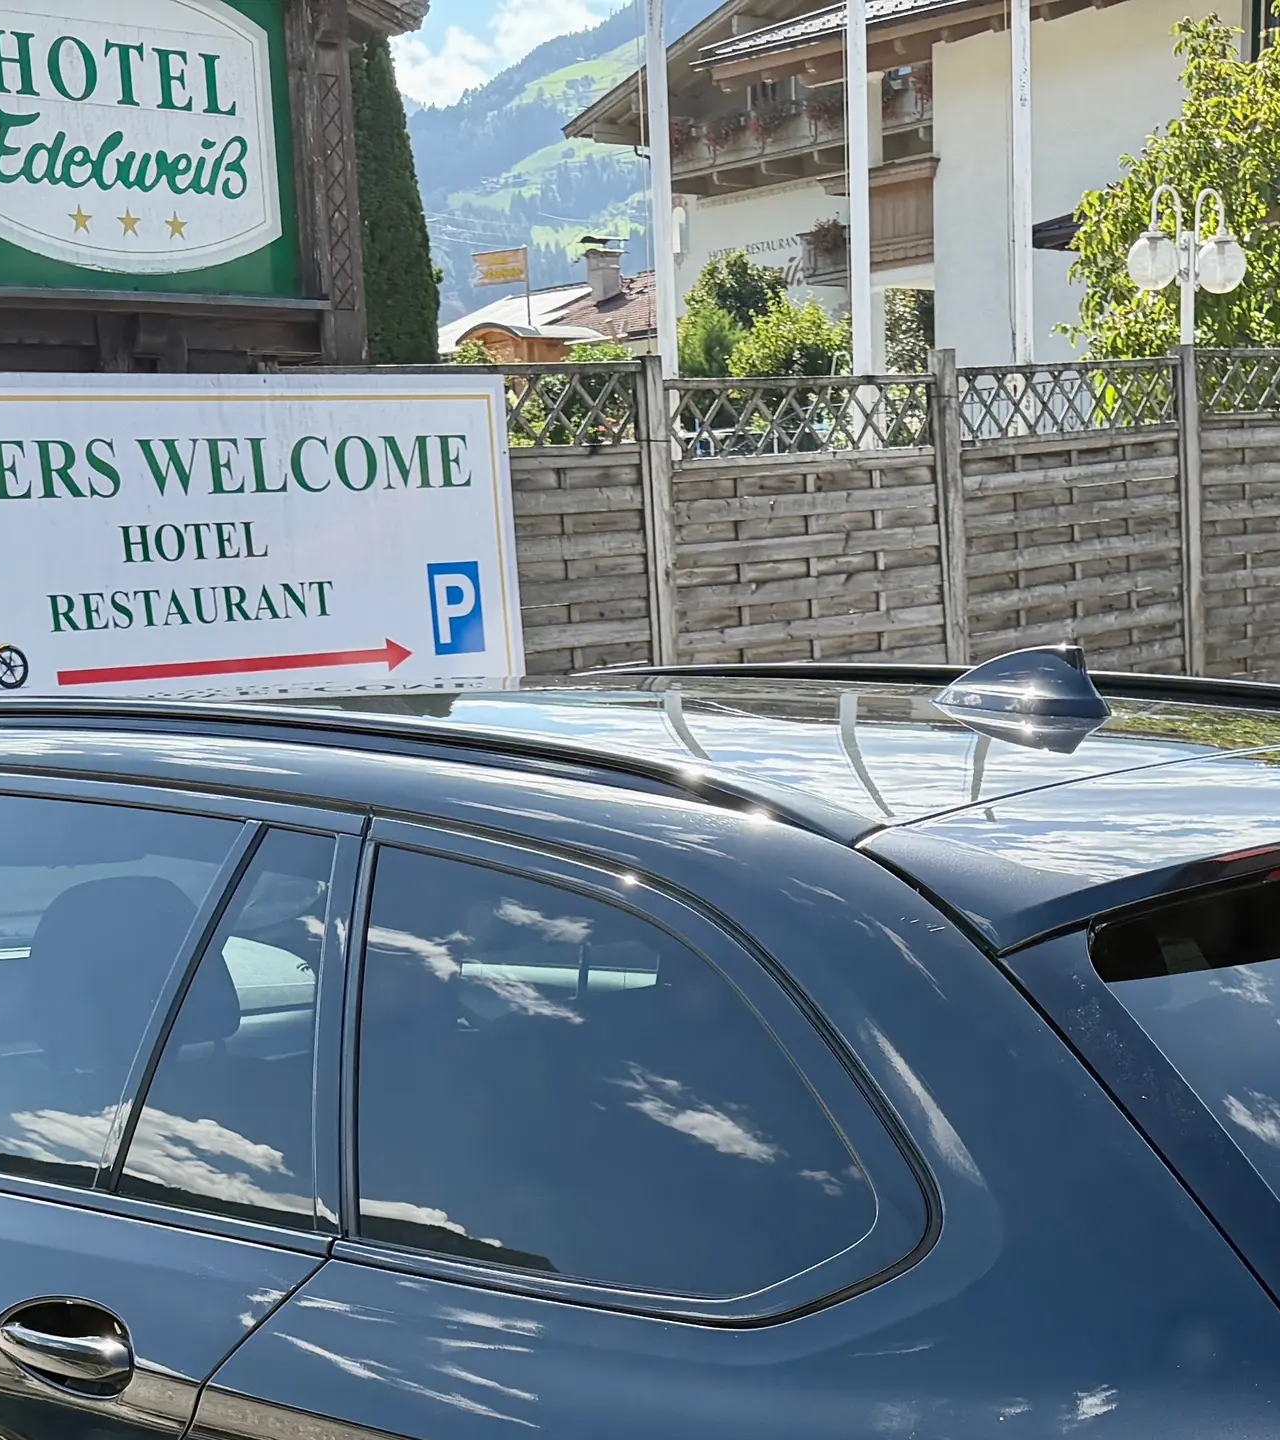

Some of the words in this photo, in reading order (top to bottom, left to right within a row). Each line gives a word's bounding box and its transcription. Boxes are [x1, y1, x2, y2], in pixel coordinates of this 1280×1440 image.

[134, 433, 474, 498] WELCOME
[118, 520, 270, 565] HOTEL
[47, 579, 334, 635] RESTAURANT
[434, 573, 476, 644] P
